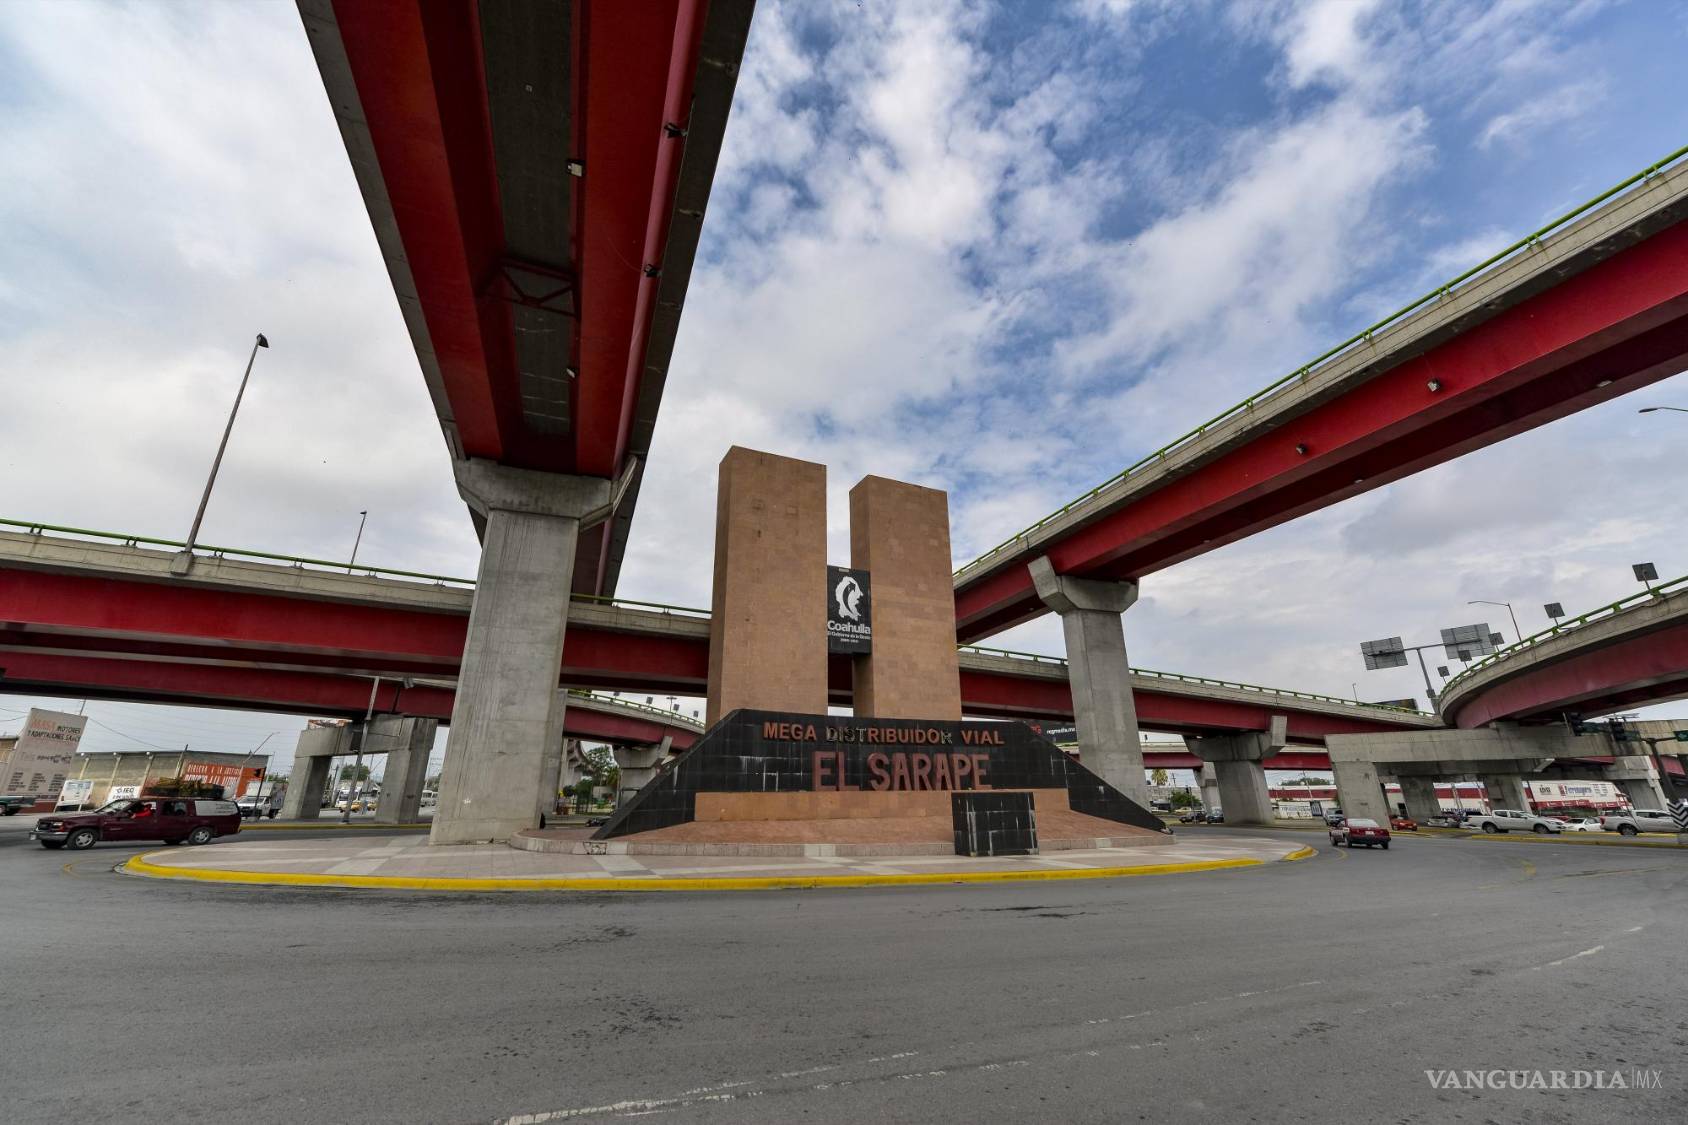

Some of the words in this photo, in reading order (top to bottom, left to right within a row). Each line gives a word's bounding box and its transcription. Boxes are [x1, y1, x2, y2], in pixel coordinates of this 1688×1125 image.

[763, 721, 817, 742] MEGA
[826, 727, 953, 745] DISTRIBUIDOR
[961, 729, 1005, 745] VIAL
[813, 751, 860, 791] EL
[867, 752, 992, 791] SARAPE
